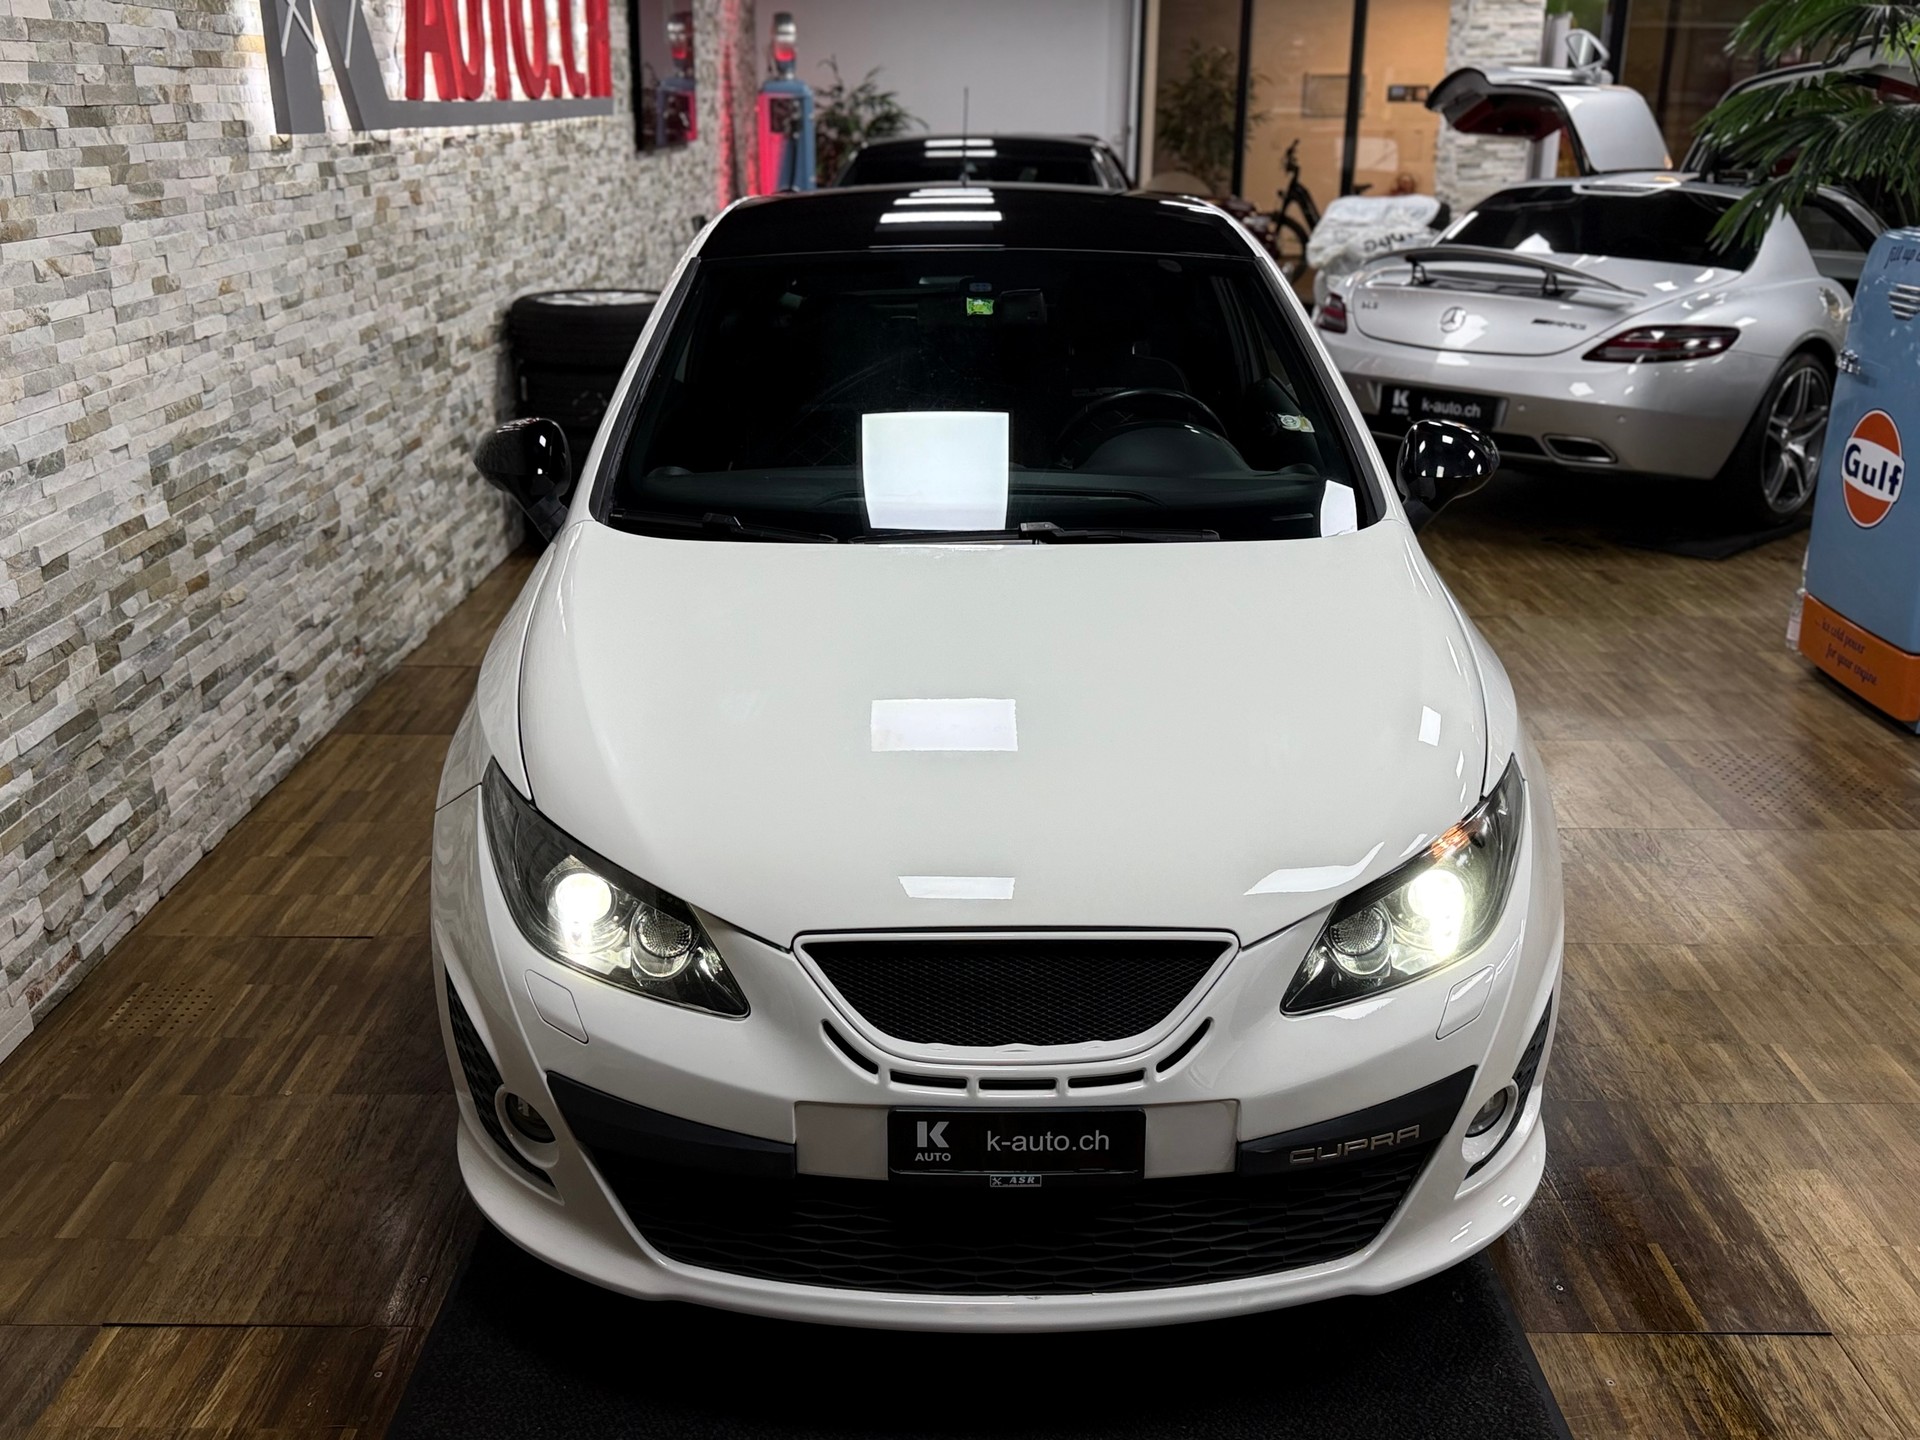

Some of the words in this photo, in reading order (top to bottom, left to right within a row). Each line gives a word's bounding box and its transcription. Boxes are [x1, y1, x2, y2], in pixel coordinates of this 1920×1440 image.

[1393, 389, 1410, 408] K
[1421, 397, 1481, 418] k-auto.ch
[1844, 443, 1902, 497] Gulf
[917, 1121, 950, 1148] K
[987, 1130, 1110, 1151] k-auto.ch
[1289, 1124, 1420, 1164] CUPRA
[914, 1152, 952, 1162] AUTO
[1009, 1176, 1035, 1184] ASR
